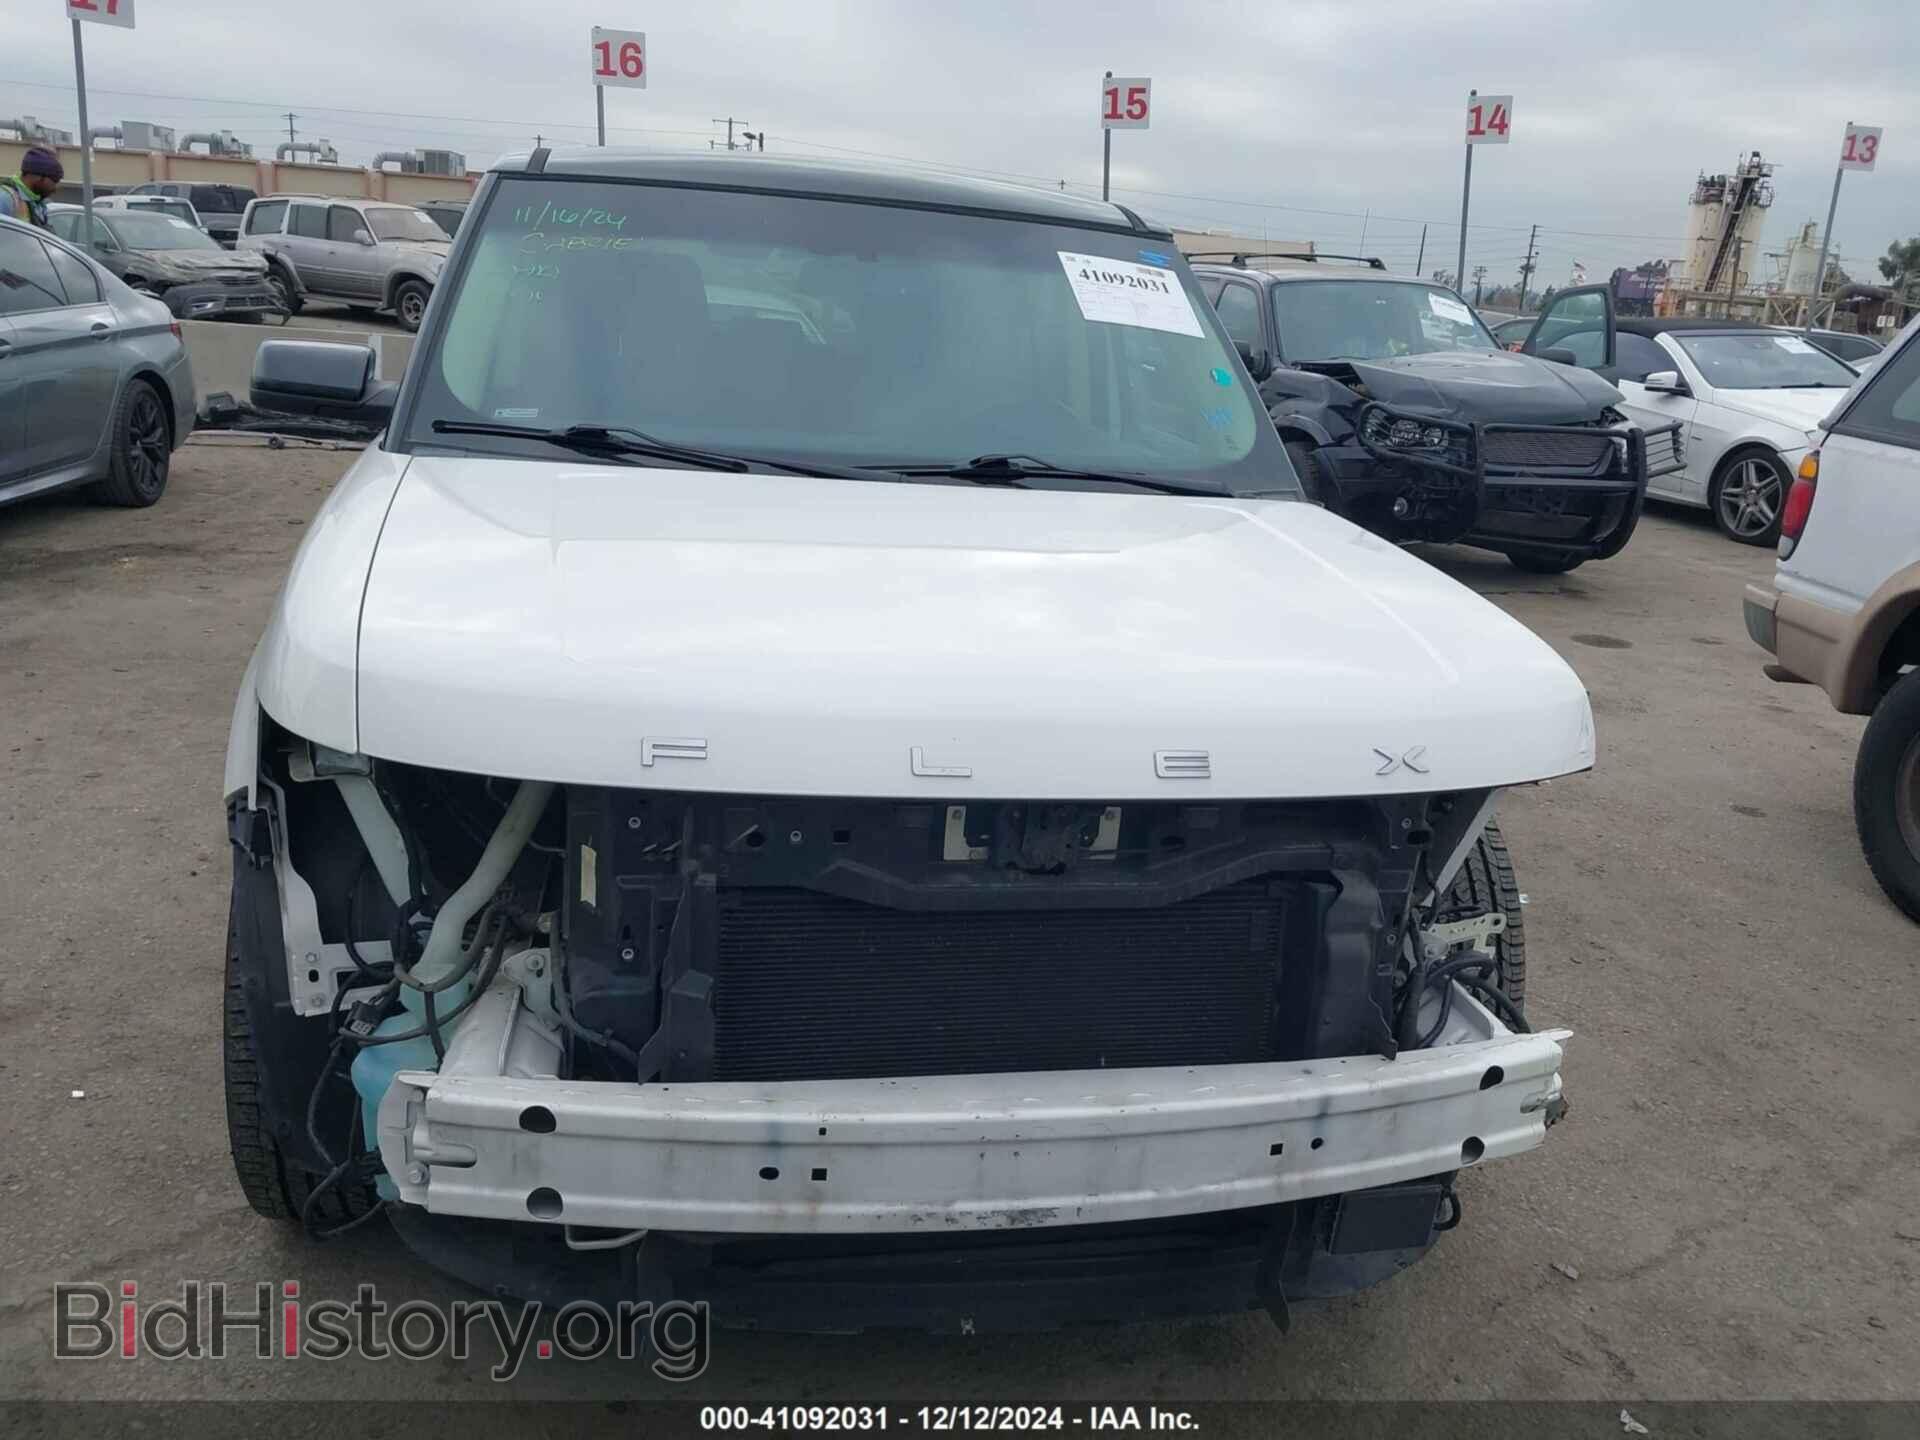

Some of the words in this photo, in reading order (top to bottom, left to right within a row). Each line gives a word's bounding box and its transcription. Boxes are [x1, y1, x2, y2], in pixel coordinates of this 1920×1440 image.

[595, 41, 643, 78] 16
[1104, 86, 1148, 120] 15
[1468, 104, 1508, 136] 14
[1842, 134, 1878, 164] 13
[1079, 268, 1170, 294] 41092031
[640, 735, 1430, 780] FLEX
